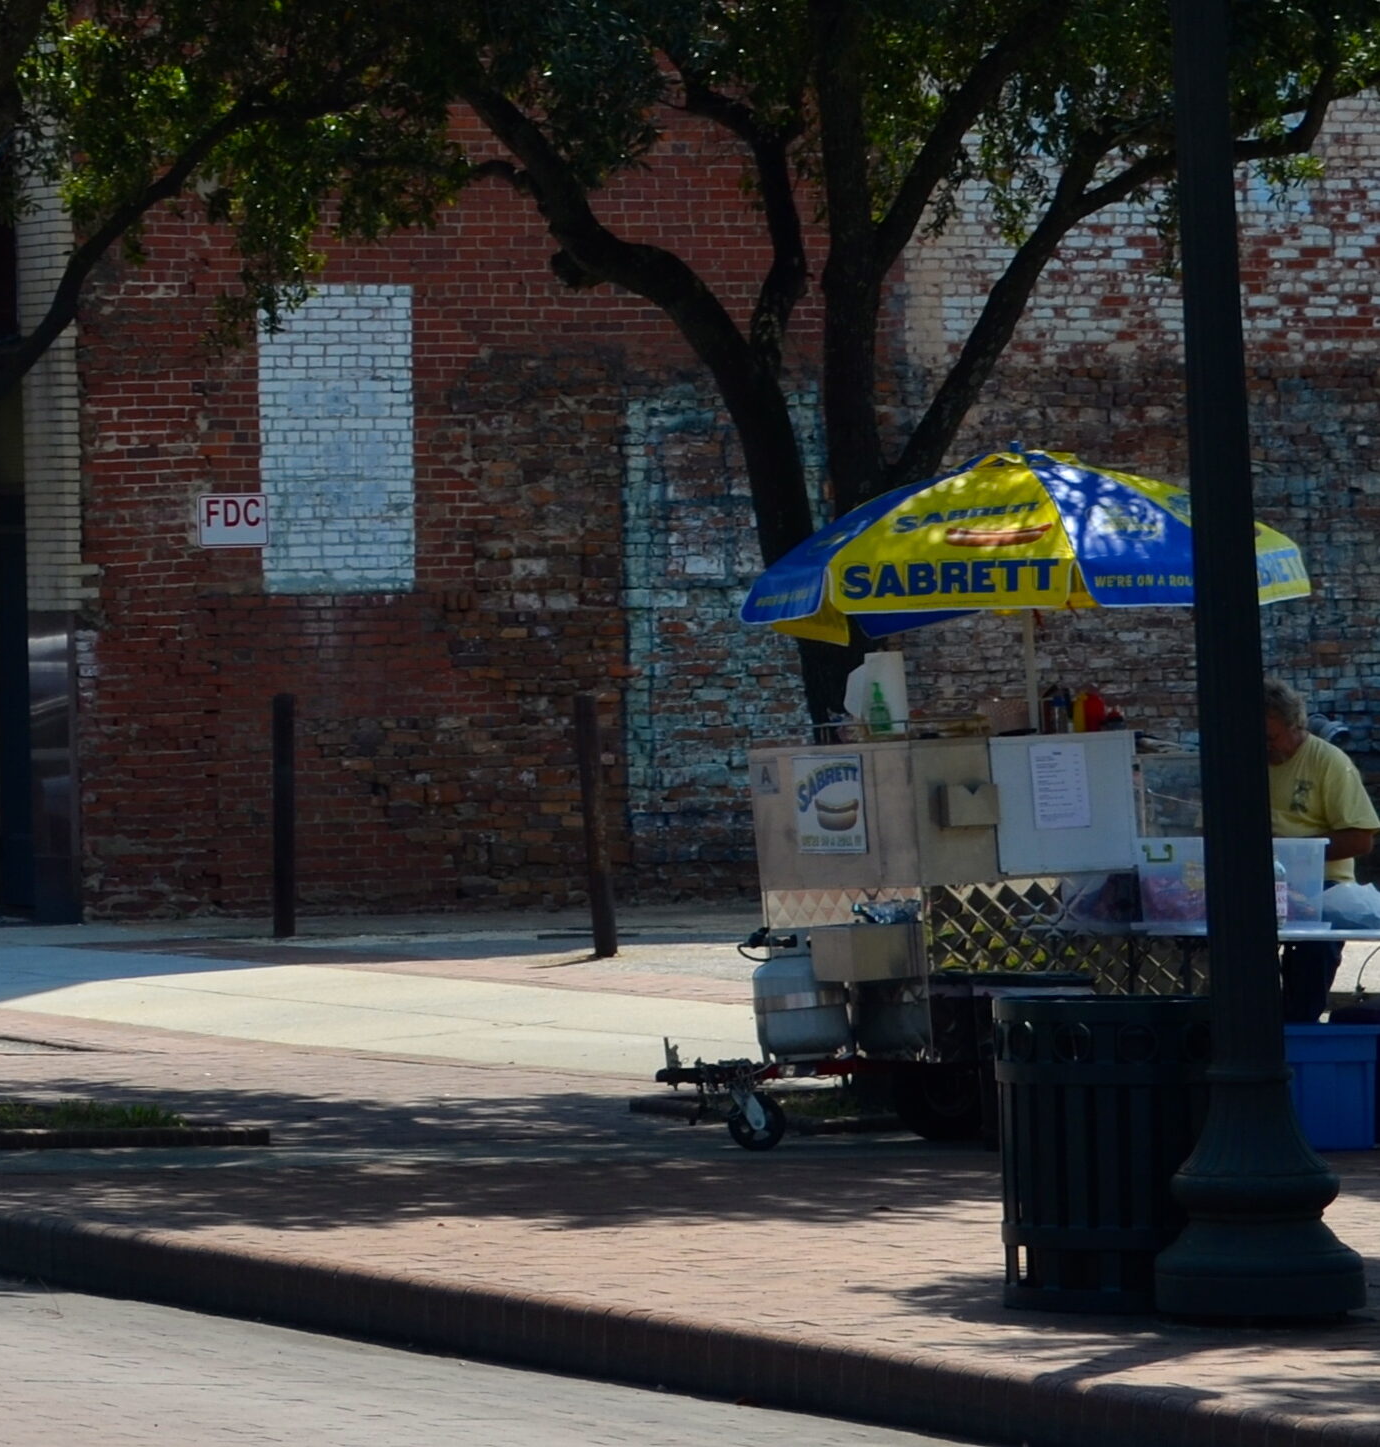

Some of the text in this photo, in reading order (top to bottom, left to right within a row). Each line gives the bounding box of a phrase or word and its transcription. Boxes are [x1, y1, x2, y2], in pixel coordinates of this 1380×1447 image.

[206, 498, 261, 528] FDC
[893, 501, 1040, 533] SABRETT
[841, 558, 1060, 600] SABRETT
[1094, 573, 1193, 588] WE'RE ON A ROL
[797, 761, 859, 813] SABRETT
